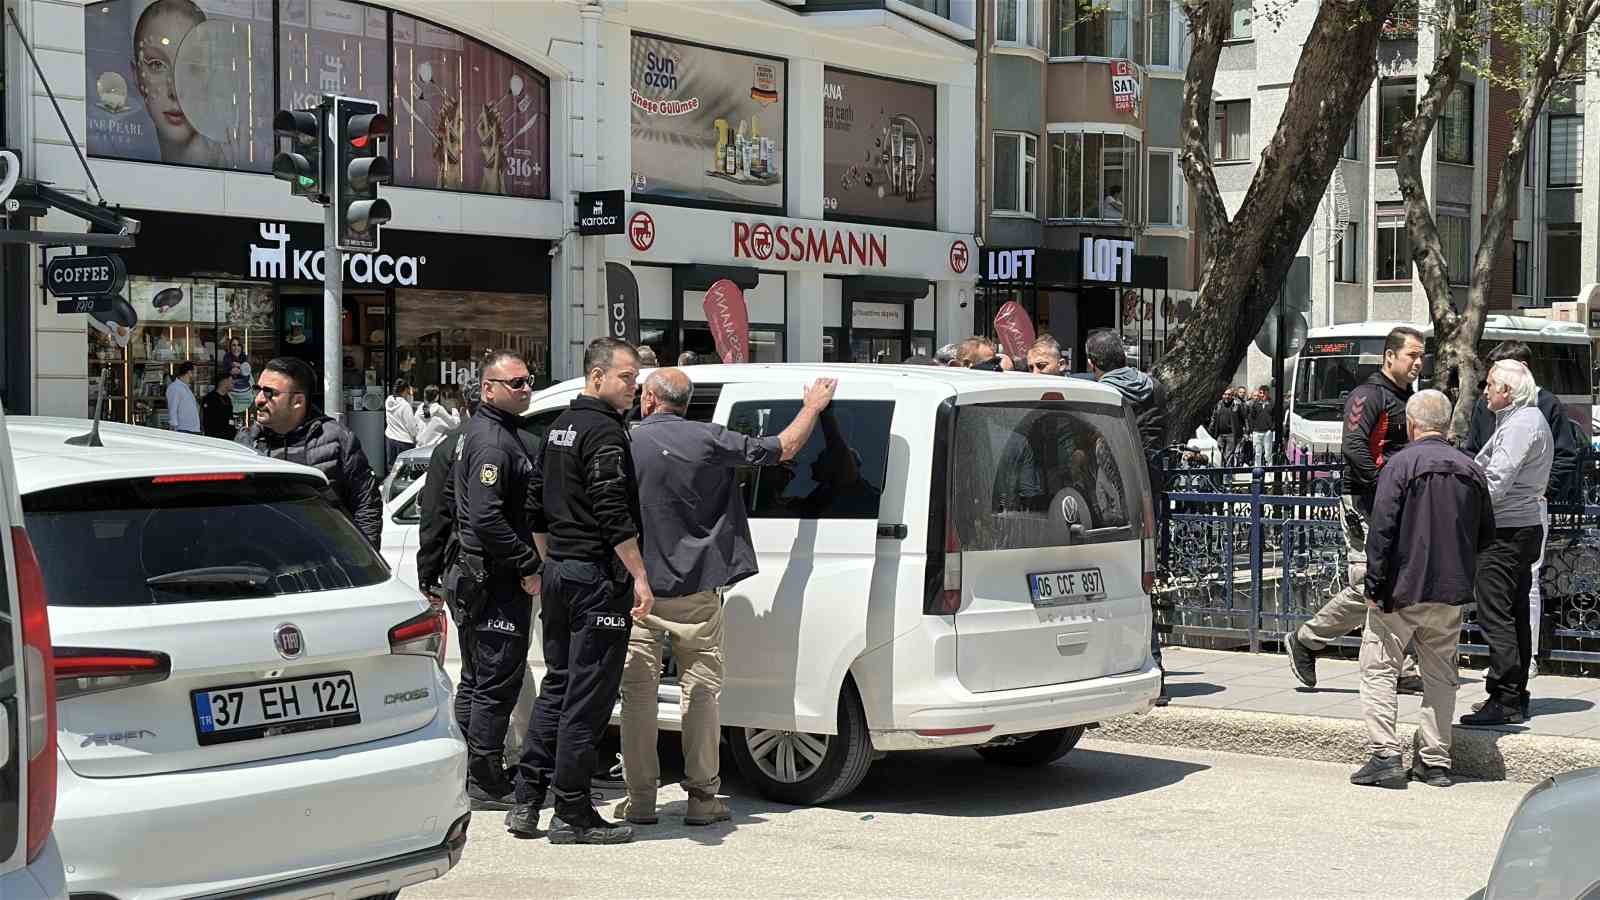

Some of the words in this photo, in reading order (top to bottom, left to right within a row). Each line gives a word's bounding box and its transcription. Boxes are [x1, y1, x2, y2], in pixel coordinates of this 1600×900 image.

[647, 52, 674, 74] Sun
[644, 72, 677, 90] ozon
[582, 215, 616, 226] karaca
[734, 222, 888, 267] ROSSMANN
[988, 250, 1036, 281] LOFT
[1083, 236, 1135, 283] LOFT
[54, 266, 109, 282] COFFEE
[1038, 577, 1052, 596] 06
[1057, 575, 1075, 594] CCF
[1081, 572, 1100, 592] 897
[282, 631, 299, 650] FIAT
[212, 692, 244, 727] 37
[260, 686, 300, 720] EH
[312, 679, 355, 713] 122
[384, 688, 430, 704] CROSS
